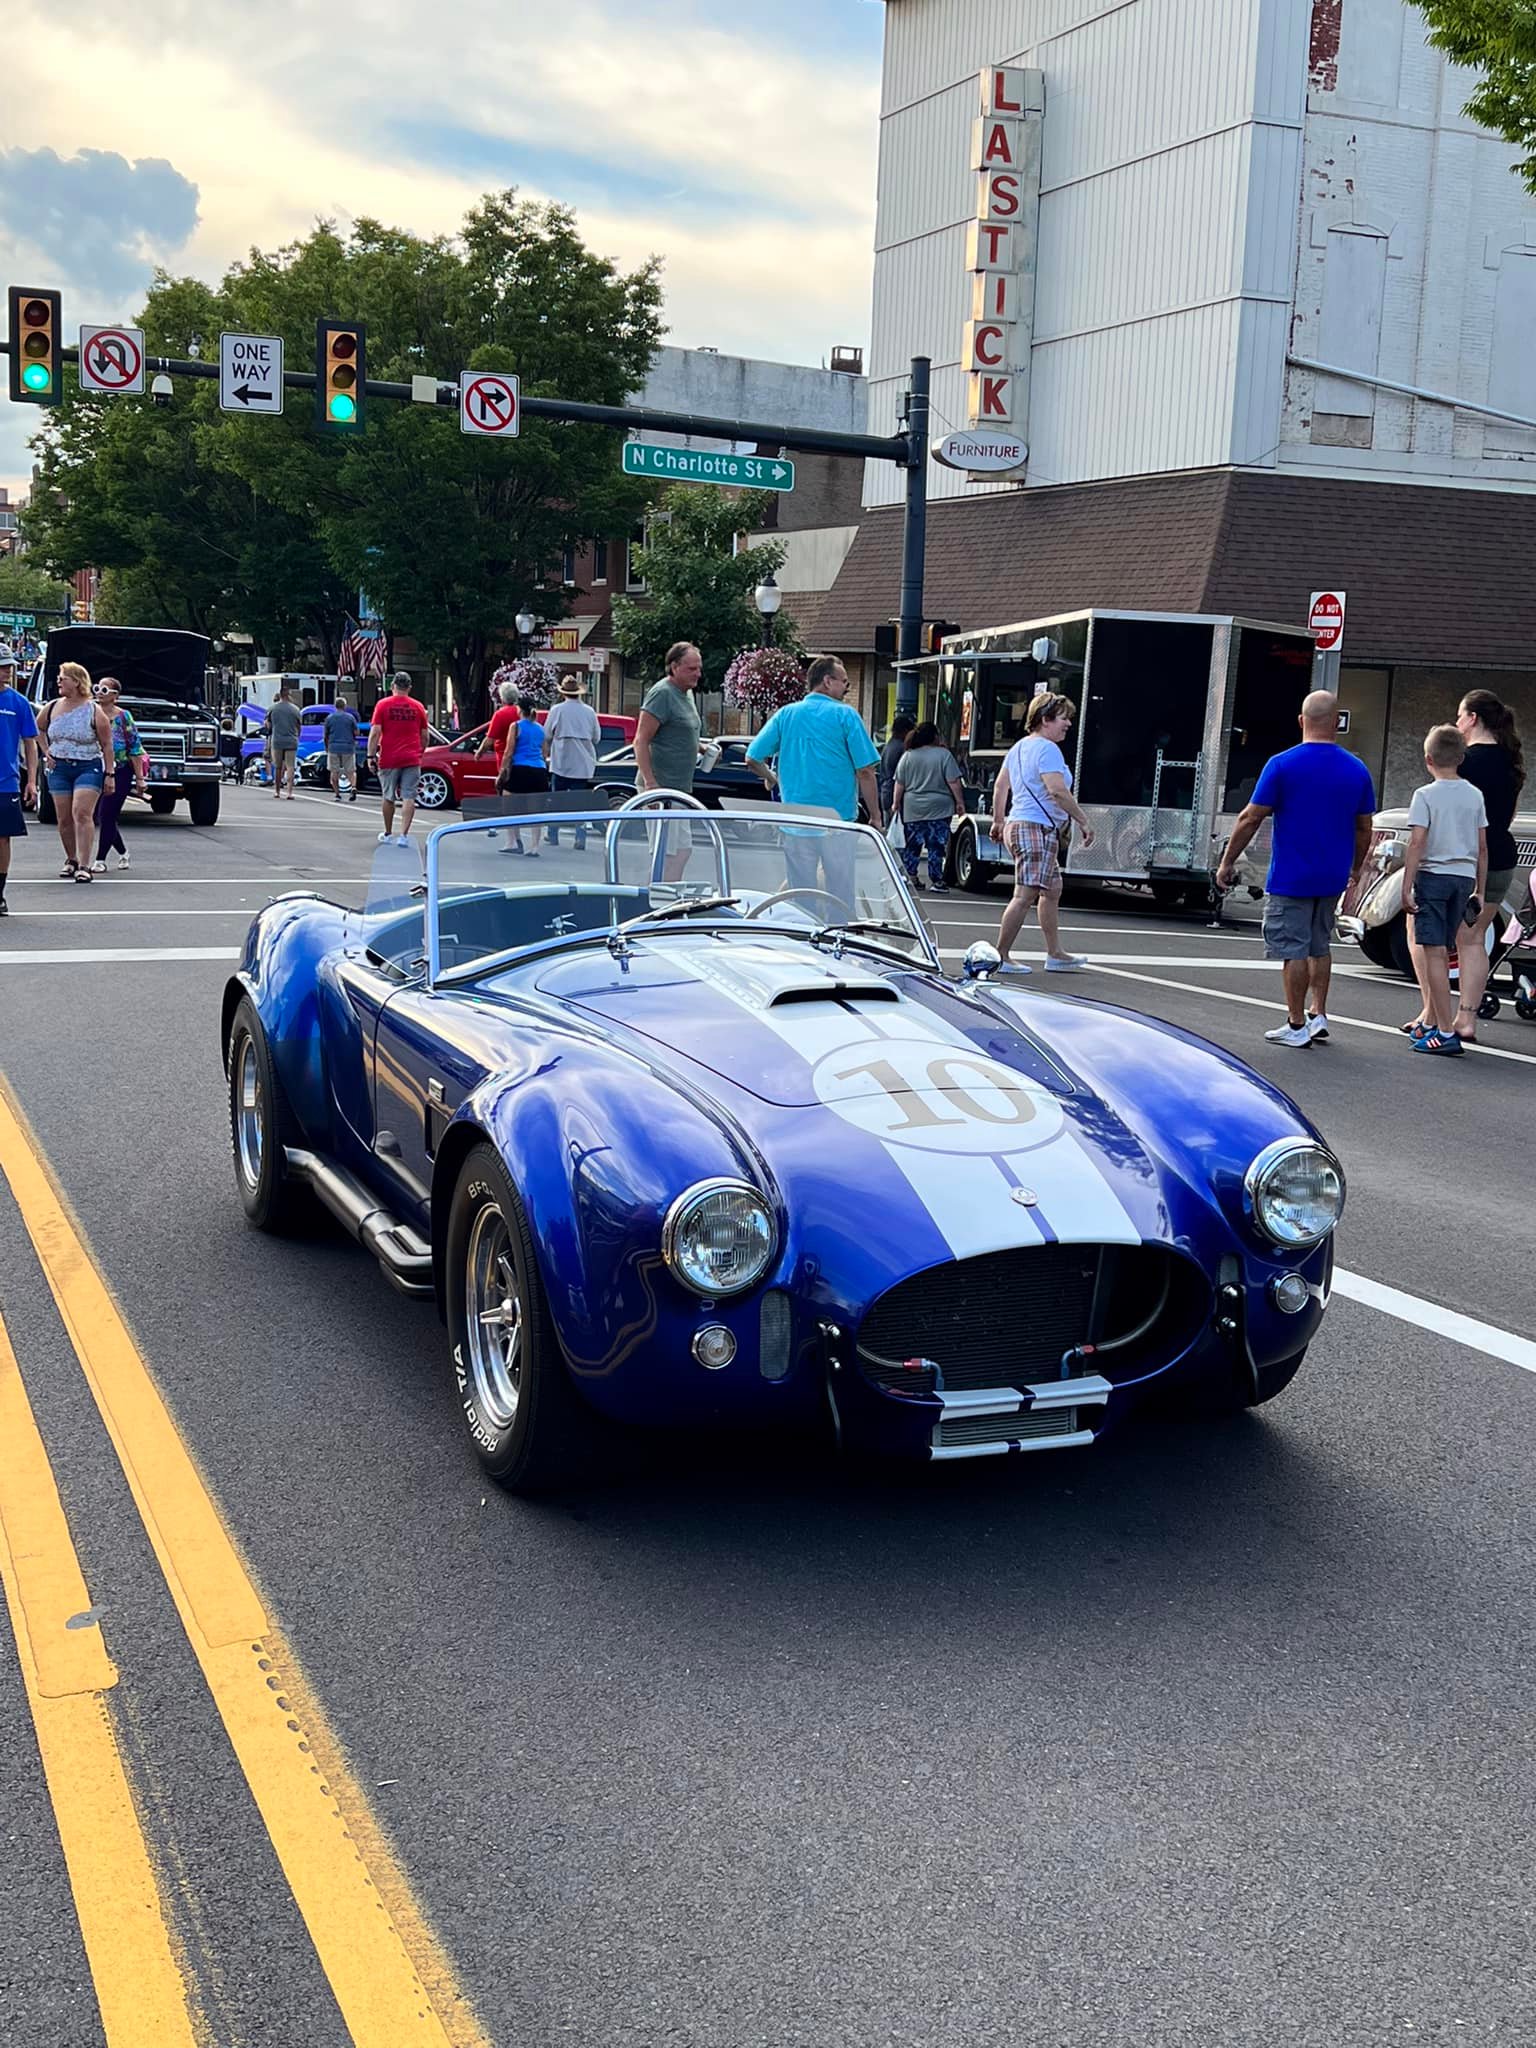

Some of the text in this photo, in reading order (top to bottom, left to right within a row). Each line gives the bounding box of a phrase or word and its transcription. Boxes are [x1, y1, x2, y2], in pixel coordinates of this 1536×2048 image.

[975, 71, 1021, 416] LASTICK
[233, 342, 270, 361] ONE
[232, 362, 271, 381] WAY
[949, 441, 1020, 458] FURNITURE
[633, 447, 763, 479] N Charlotte St
[1314, 604, 1339, 614] DO NOT
[833, 1058, 1037, 1131] 10
